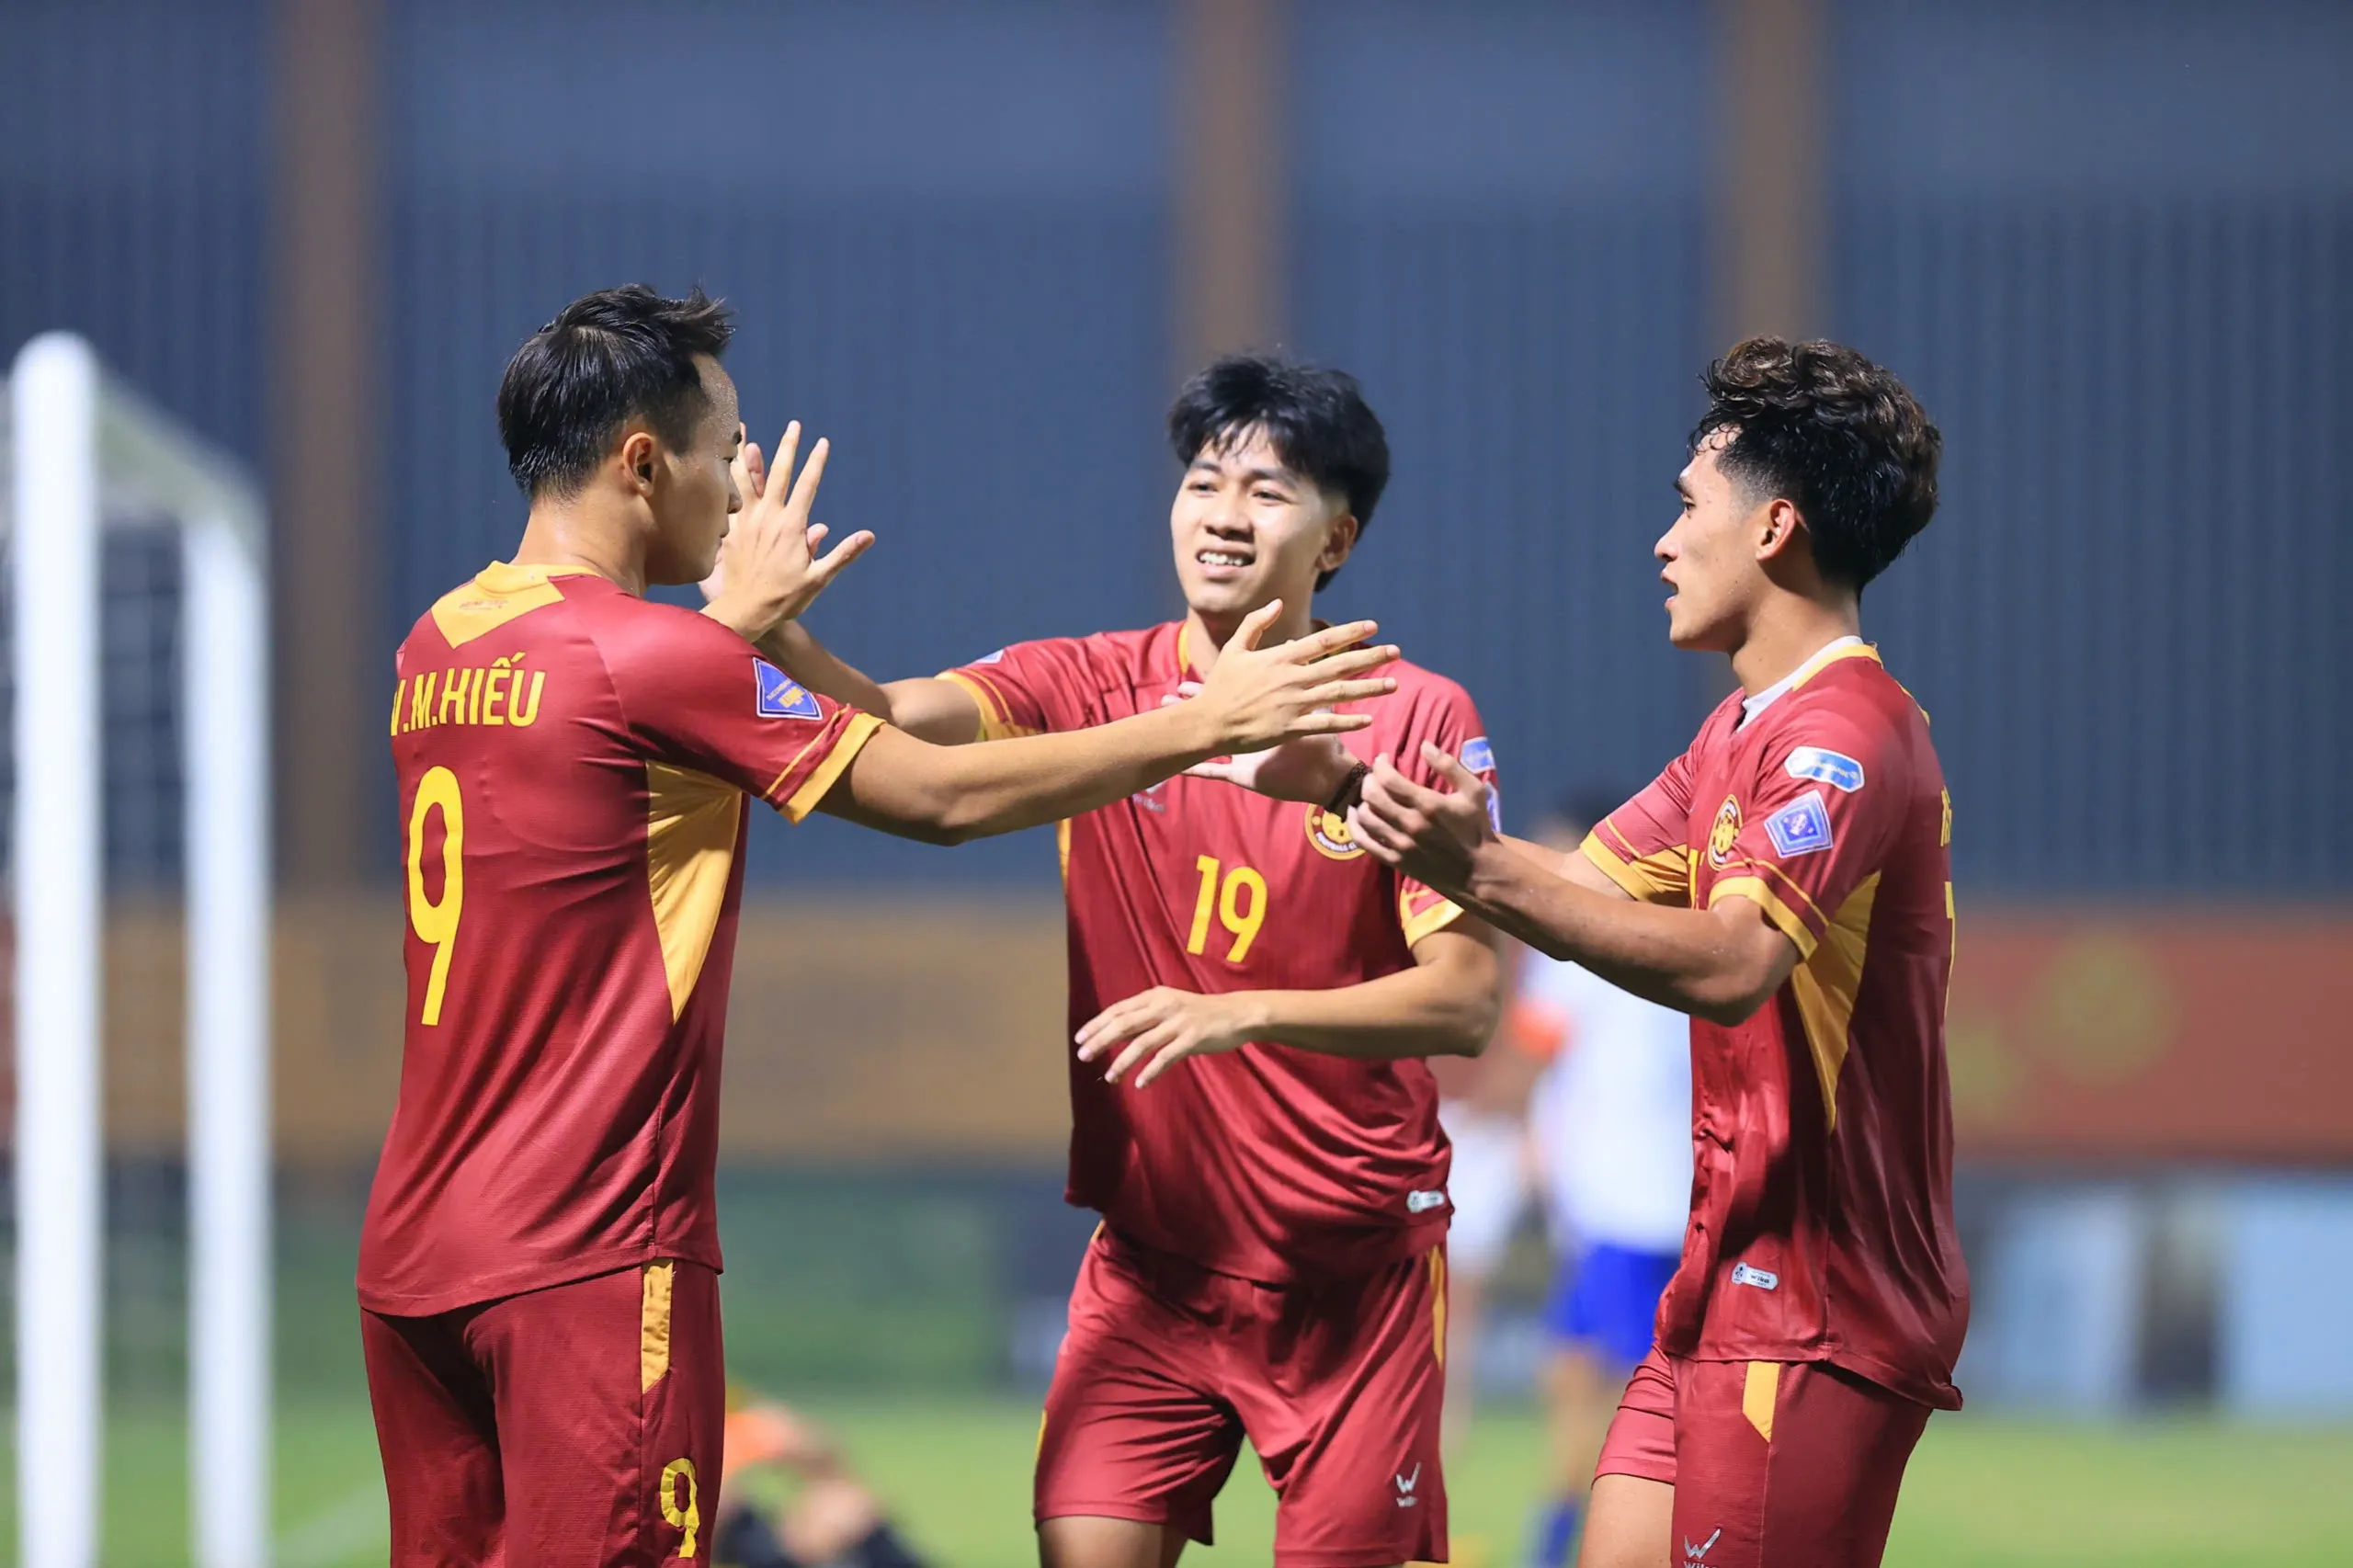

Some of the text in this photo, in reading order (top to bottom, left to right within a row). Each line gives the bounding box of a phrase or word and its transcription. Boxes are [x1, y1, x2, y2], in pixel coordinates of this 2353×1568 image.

[407, 766, 464, 1027] 9
[1187, 854, 1267, 963] 19
[660, 1458, 700, 1559] 9
